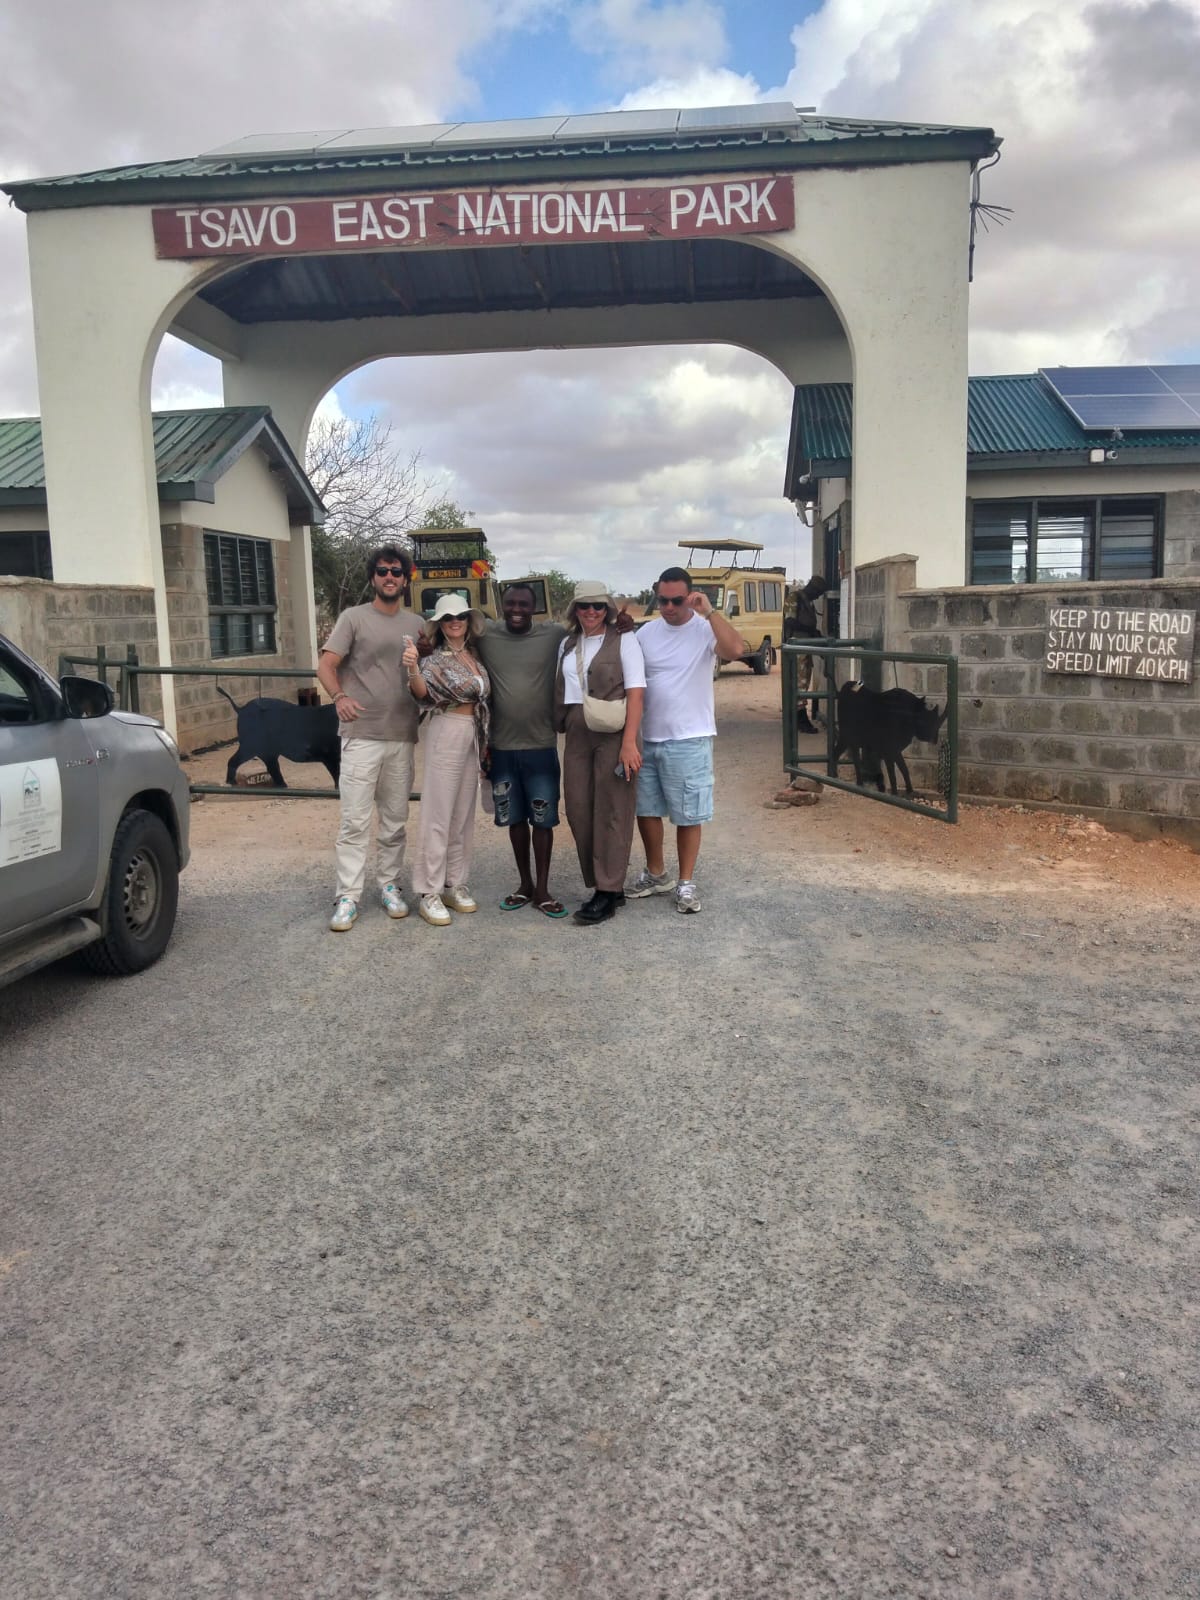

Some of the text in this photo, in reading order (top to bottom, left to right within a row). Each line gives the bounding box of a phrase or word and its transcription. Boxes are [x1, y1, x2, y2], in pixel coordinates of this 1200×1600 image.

[176, 180, 777, 249] TSAVO EAST NATIONAL PARK
[1050, 609, 1191, 634] KEEP TO THE ROAD
[1048, 630, 1178, 655] STAY IN YOUR CAR
[1047, 652, 1093, 671] SPEED
[1096, 654, 1132, 674] LIMIT
[1136, 657, 1155, 676] 40
